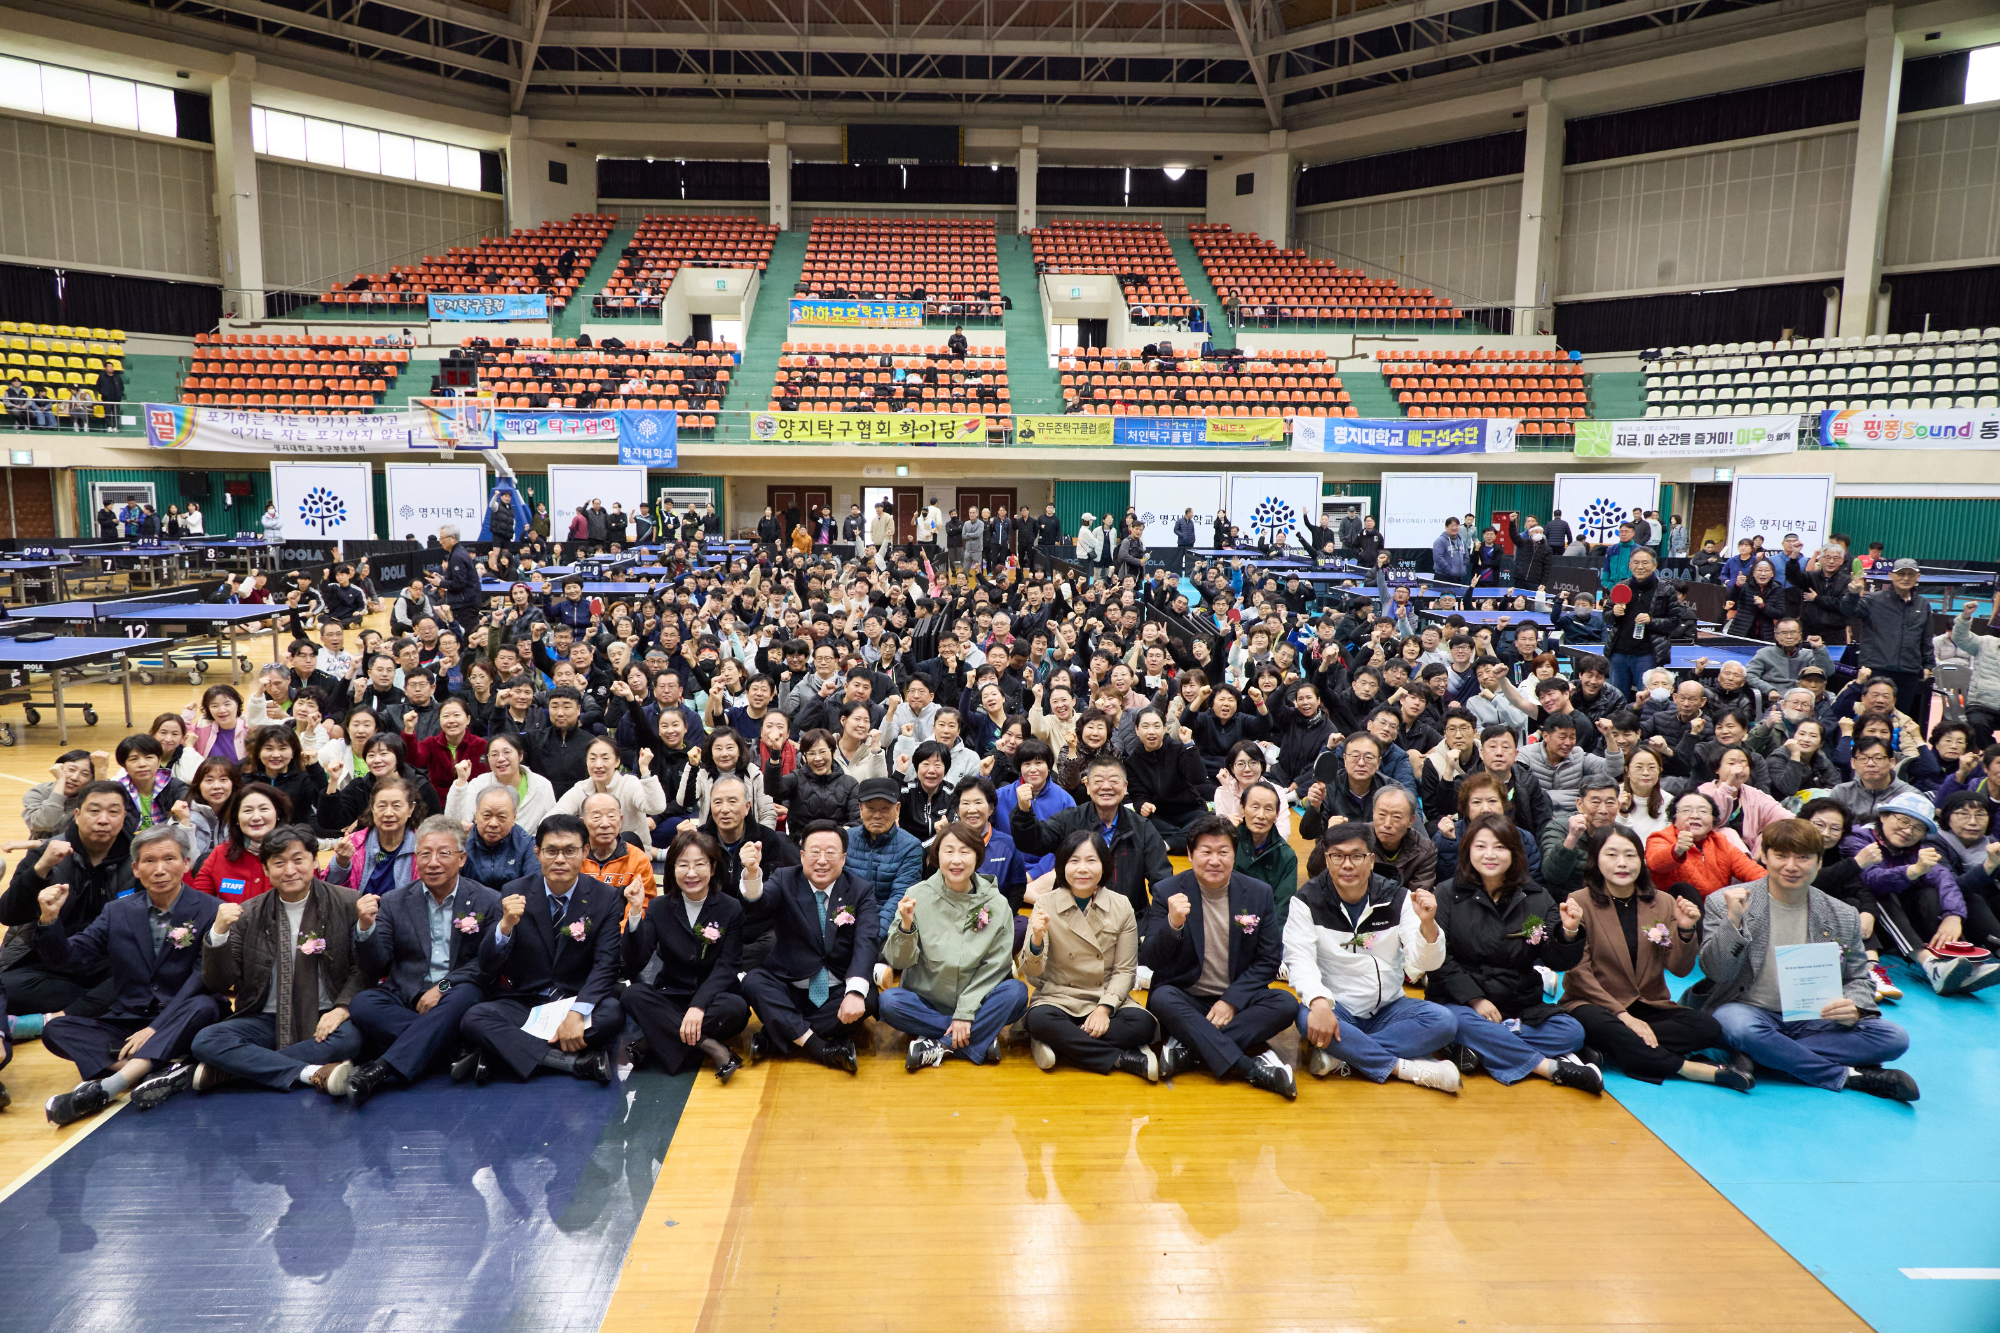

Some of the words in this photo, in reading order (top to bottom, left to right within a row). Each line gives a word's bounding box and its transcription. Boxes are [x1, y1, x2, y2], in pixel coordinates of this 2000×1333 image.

[434, 297, 505, 316] 명지탁구클럽
[801, 305, 860, 323] 하하호호
[861, 305, 920, 319] 탁구동호회
[151, 410, 177, 441] 필
[207, 411, 264, 425] 포기하는
[272, 415, 299, 427] 자는
[308, 416, 349, 427] 이기지
[357, 415, 398, 427] 못하고
[505, 419, 539, 435] 백암
[548, 418, 616, 435] 탁구협회
[778, 419, 891, 439] 양지탁구협회
[899, 419, 956, 439] 화이팅
[1037, 422, 1097, 434] 유두준탁구클럽
[1833, 422, 1849, 436] 필
[1864, 420, 1974, 440] 핑퐁Sound
[231, 427, 278, 440] 이기는
[281, 430, 308, 441] 자는
[315, 430, 373, 441] 포기하지
[1128, 430, 1192, 444] 처인탁구클럽
[1334, 427, 1403, 446] 명지대학교
[1407, 427, 1478, 447] 배구선수단
[1616, 434, 1641, 447] 지금,
[1644, 434, 1654, 446] 이
[1658, 433, 1691, 446] 순간을
[1694, 432, 1733, 445] 즐거이!
[273, 444, 314, 452] 명지대학교
[622, 447, 673, 459] 명지대학교
[419, 507, 475, 519] 명지대학교
[1160, 514, 1214, 525] 명지학교
[1760, 519, 1817, 532] 명지대학교
[42, 548, 49, 556] 0
[207, 549, 215, 558] 8
[104, 560, 112, 570] 7
[593, 566, 598, 575] 8
[381, 565, 406, 581] JOOLA
[1389, 572, 1394, 580] 6
[1409, 572, 1414, 580] 3
[1558, 582, 1580, 592] JOOLA
[124, 625, 146, 638] 12
[222, 882, 244, 890] STAFF
